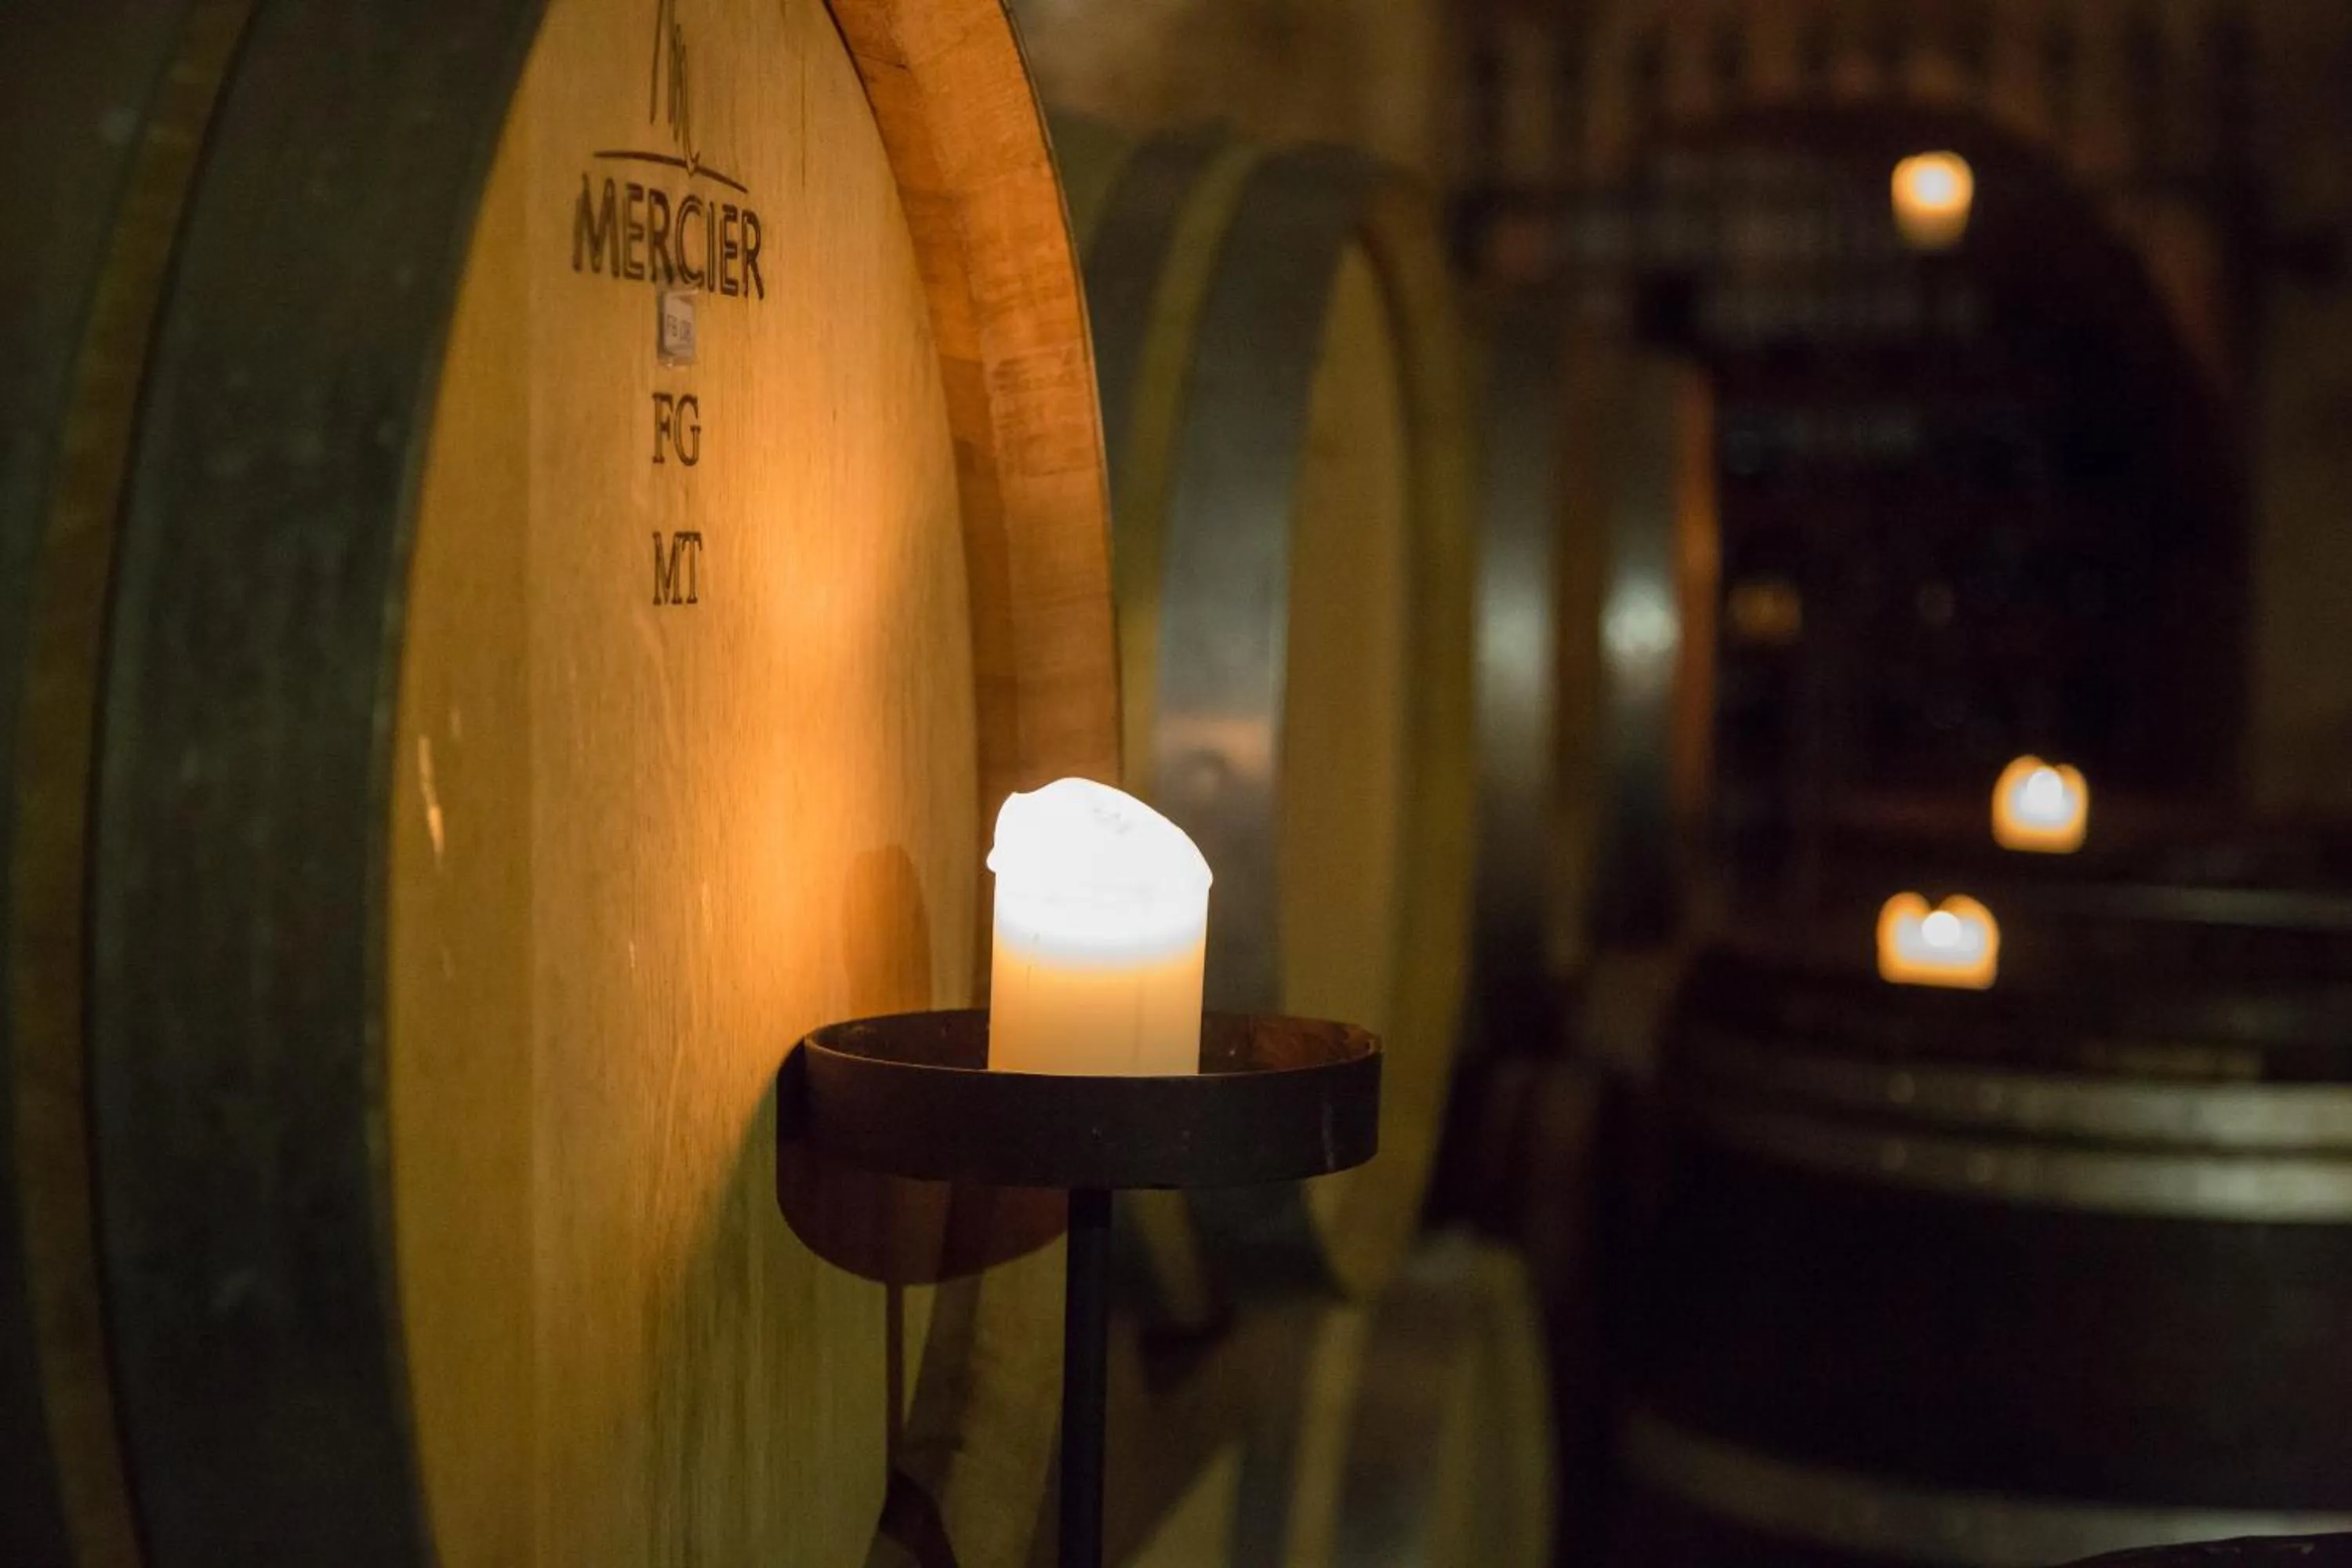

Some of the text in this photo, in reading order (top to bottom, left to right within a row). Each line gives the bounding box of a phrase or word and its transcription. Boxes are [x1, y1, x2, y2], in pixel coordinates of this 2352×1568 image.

[572, 171, 764, 301] MERCIER
[652, 392, 701, 466] FG
[652, 531, 702, 605] MT
